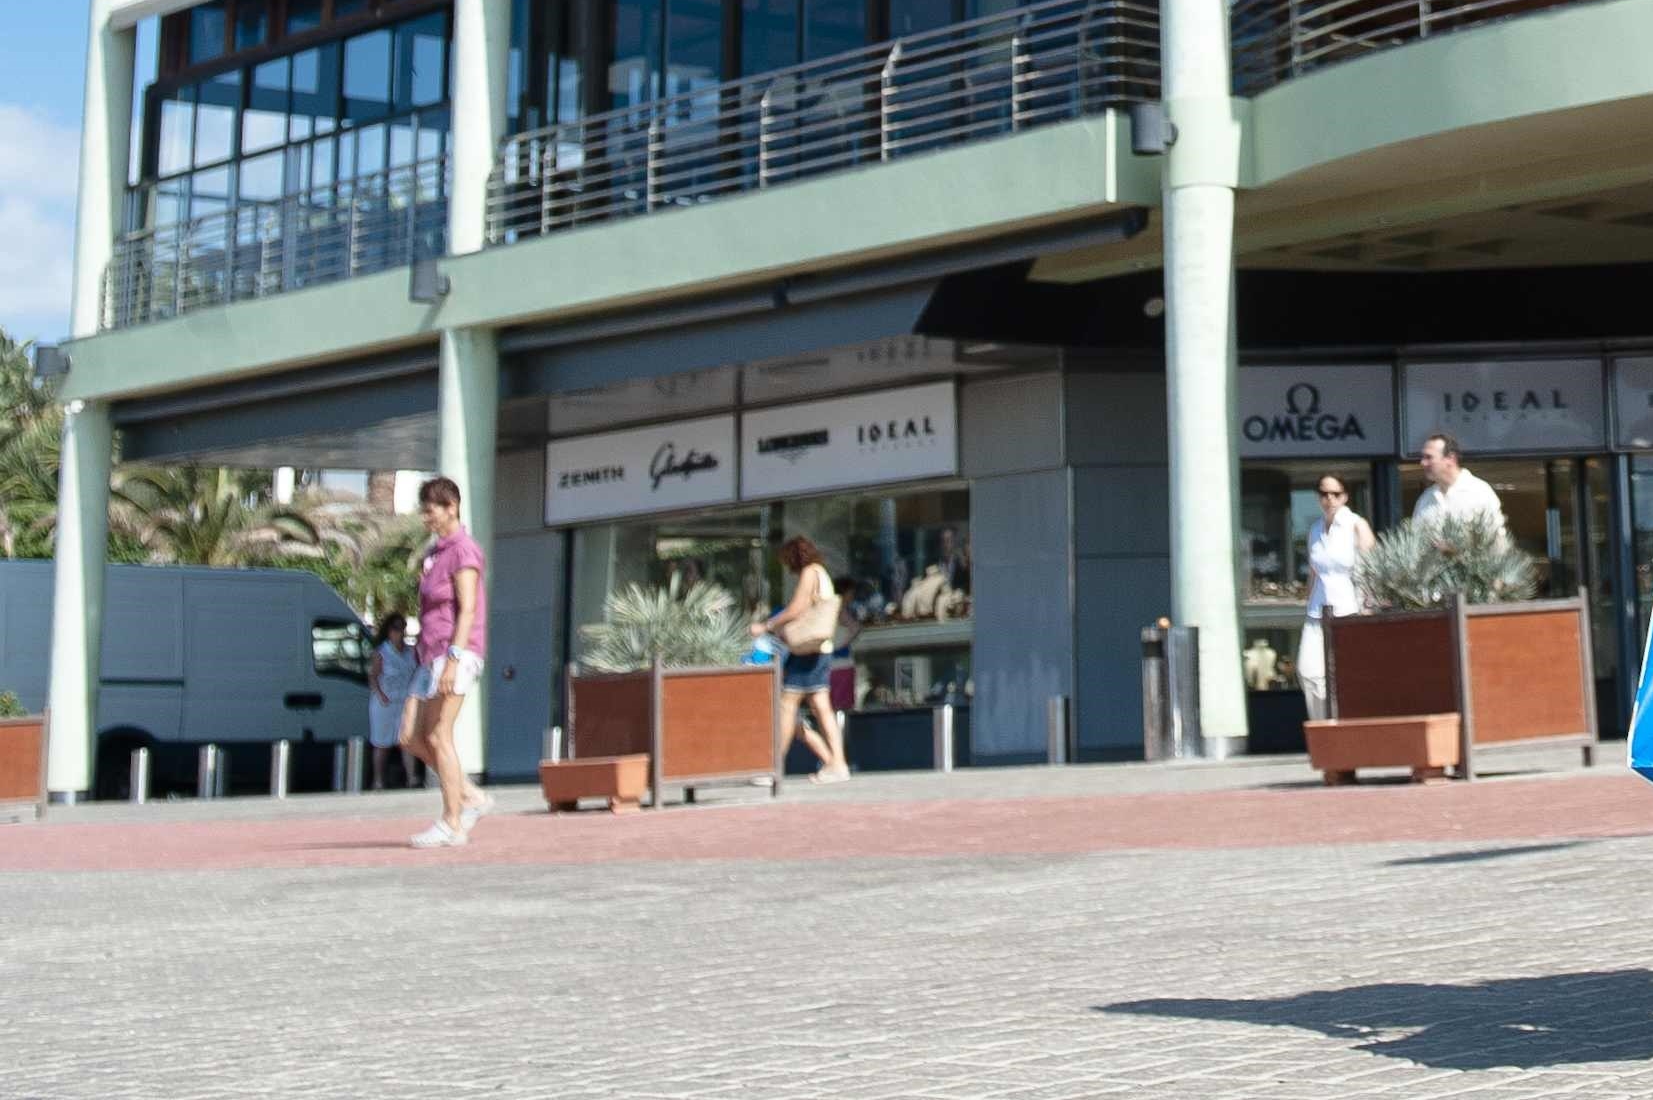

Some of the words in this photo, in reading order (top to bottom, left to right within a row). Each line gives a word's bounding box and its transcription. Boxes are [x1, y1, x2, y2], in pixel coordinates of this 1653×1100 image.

[1444, 390, 1568, 412] IDEAL
[857, 415, 935, 444] IDEAL
[1243, 414, 1366, 442] OMEGA
[558, 465, 625, 488] ZENITH
